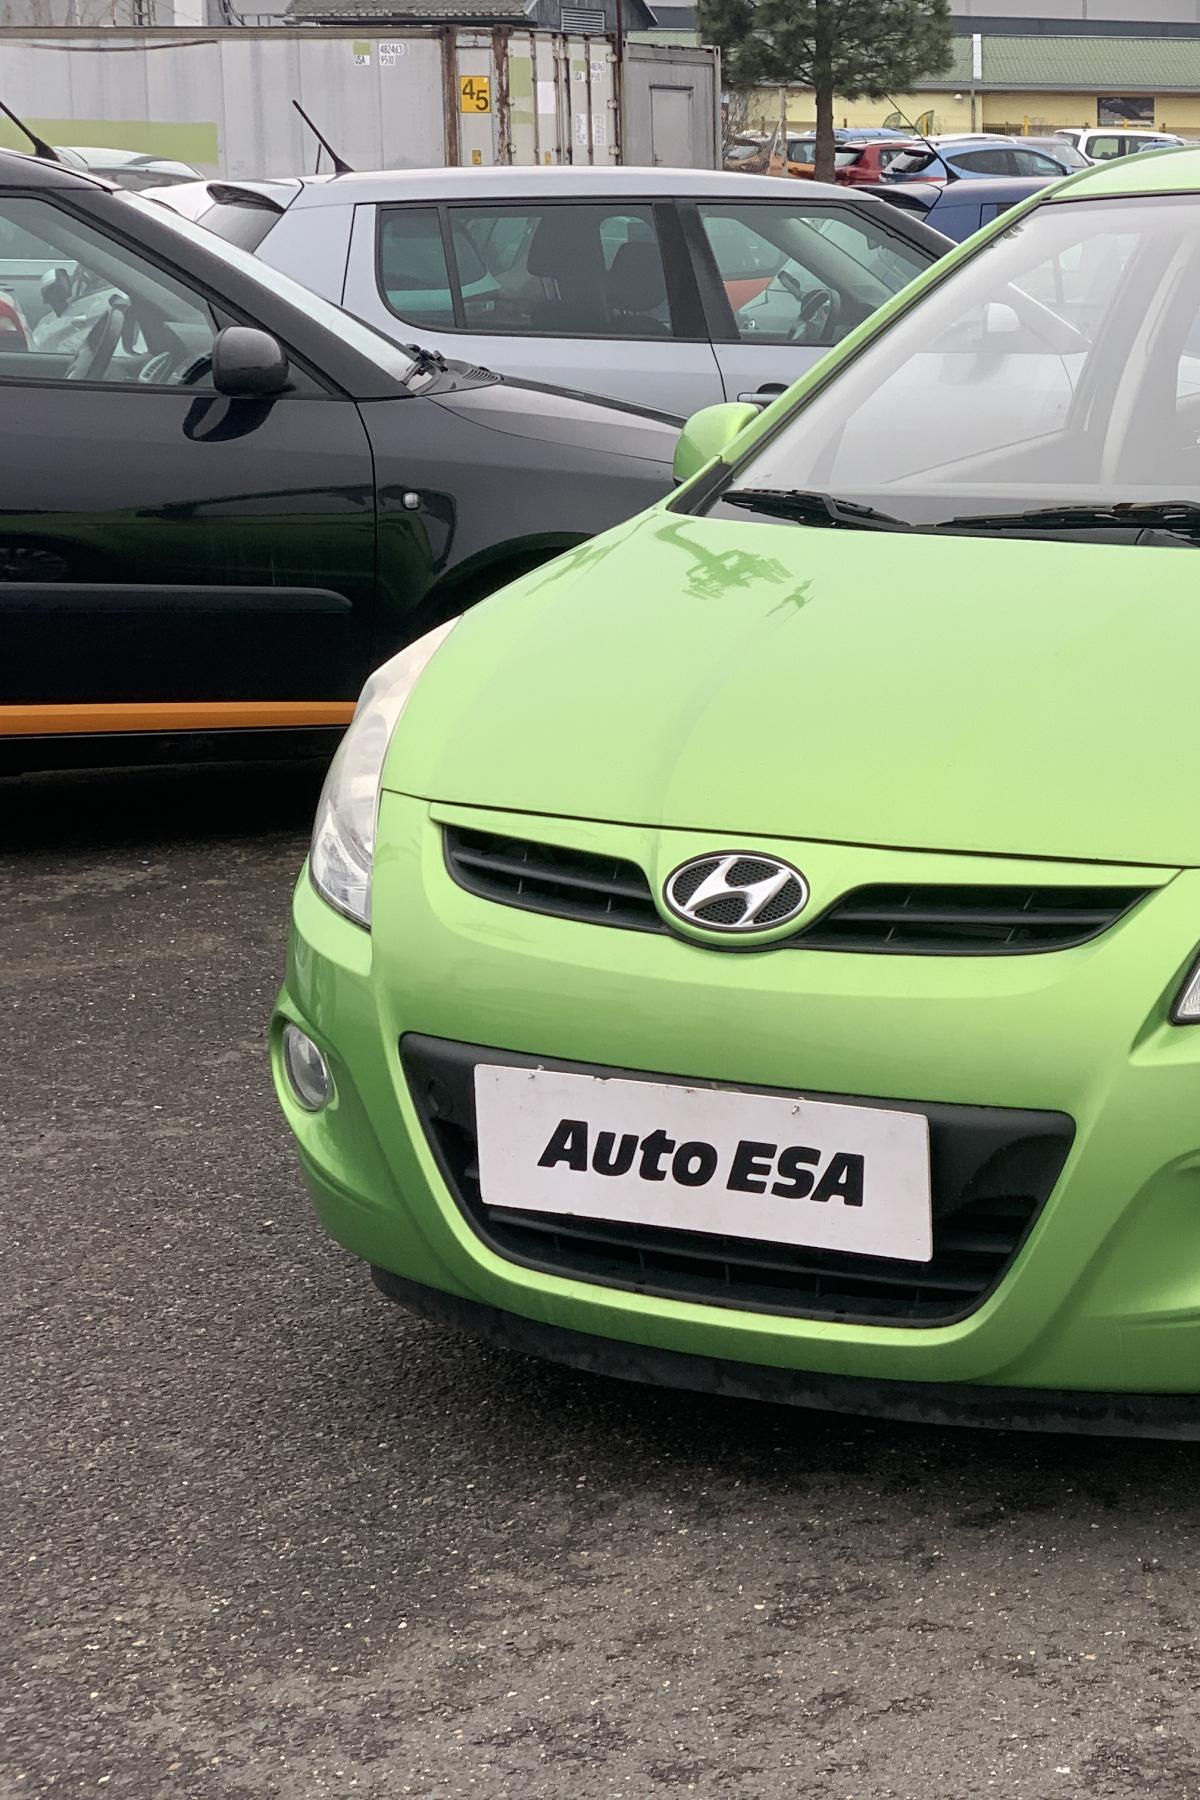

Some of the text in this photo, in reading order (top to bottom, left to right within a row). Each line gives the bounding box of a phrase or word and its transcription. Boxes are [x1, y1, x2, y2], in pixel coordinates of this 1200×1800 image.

[462, 78, 489, 111] 45
[537, 1119, 865, 1207] Auto ESA
